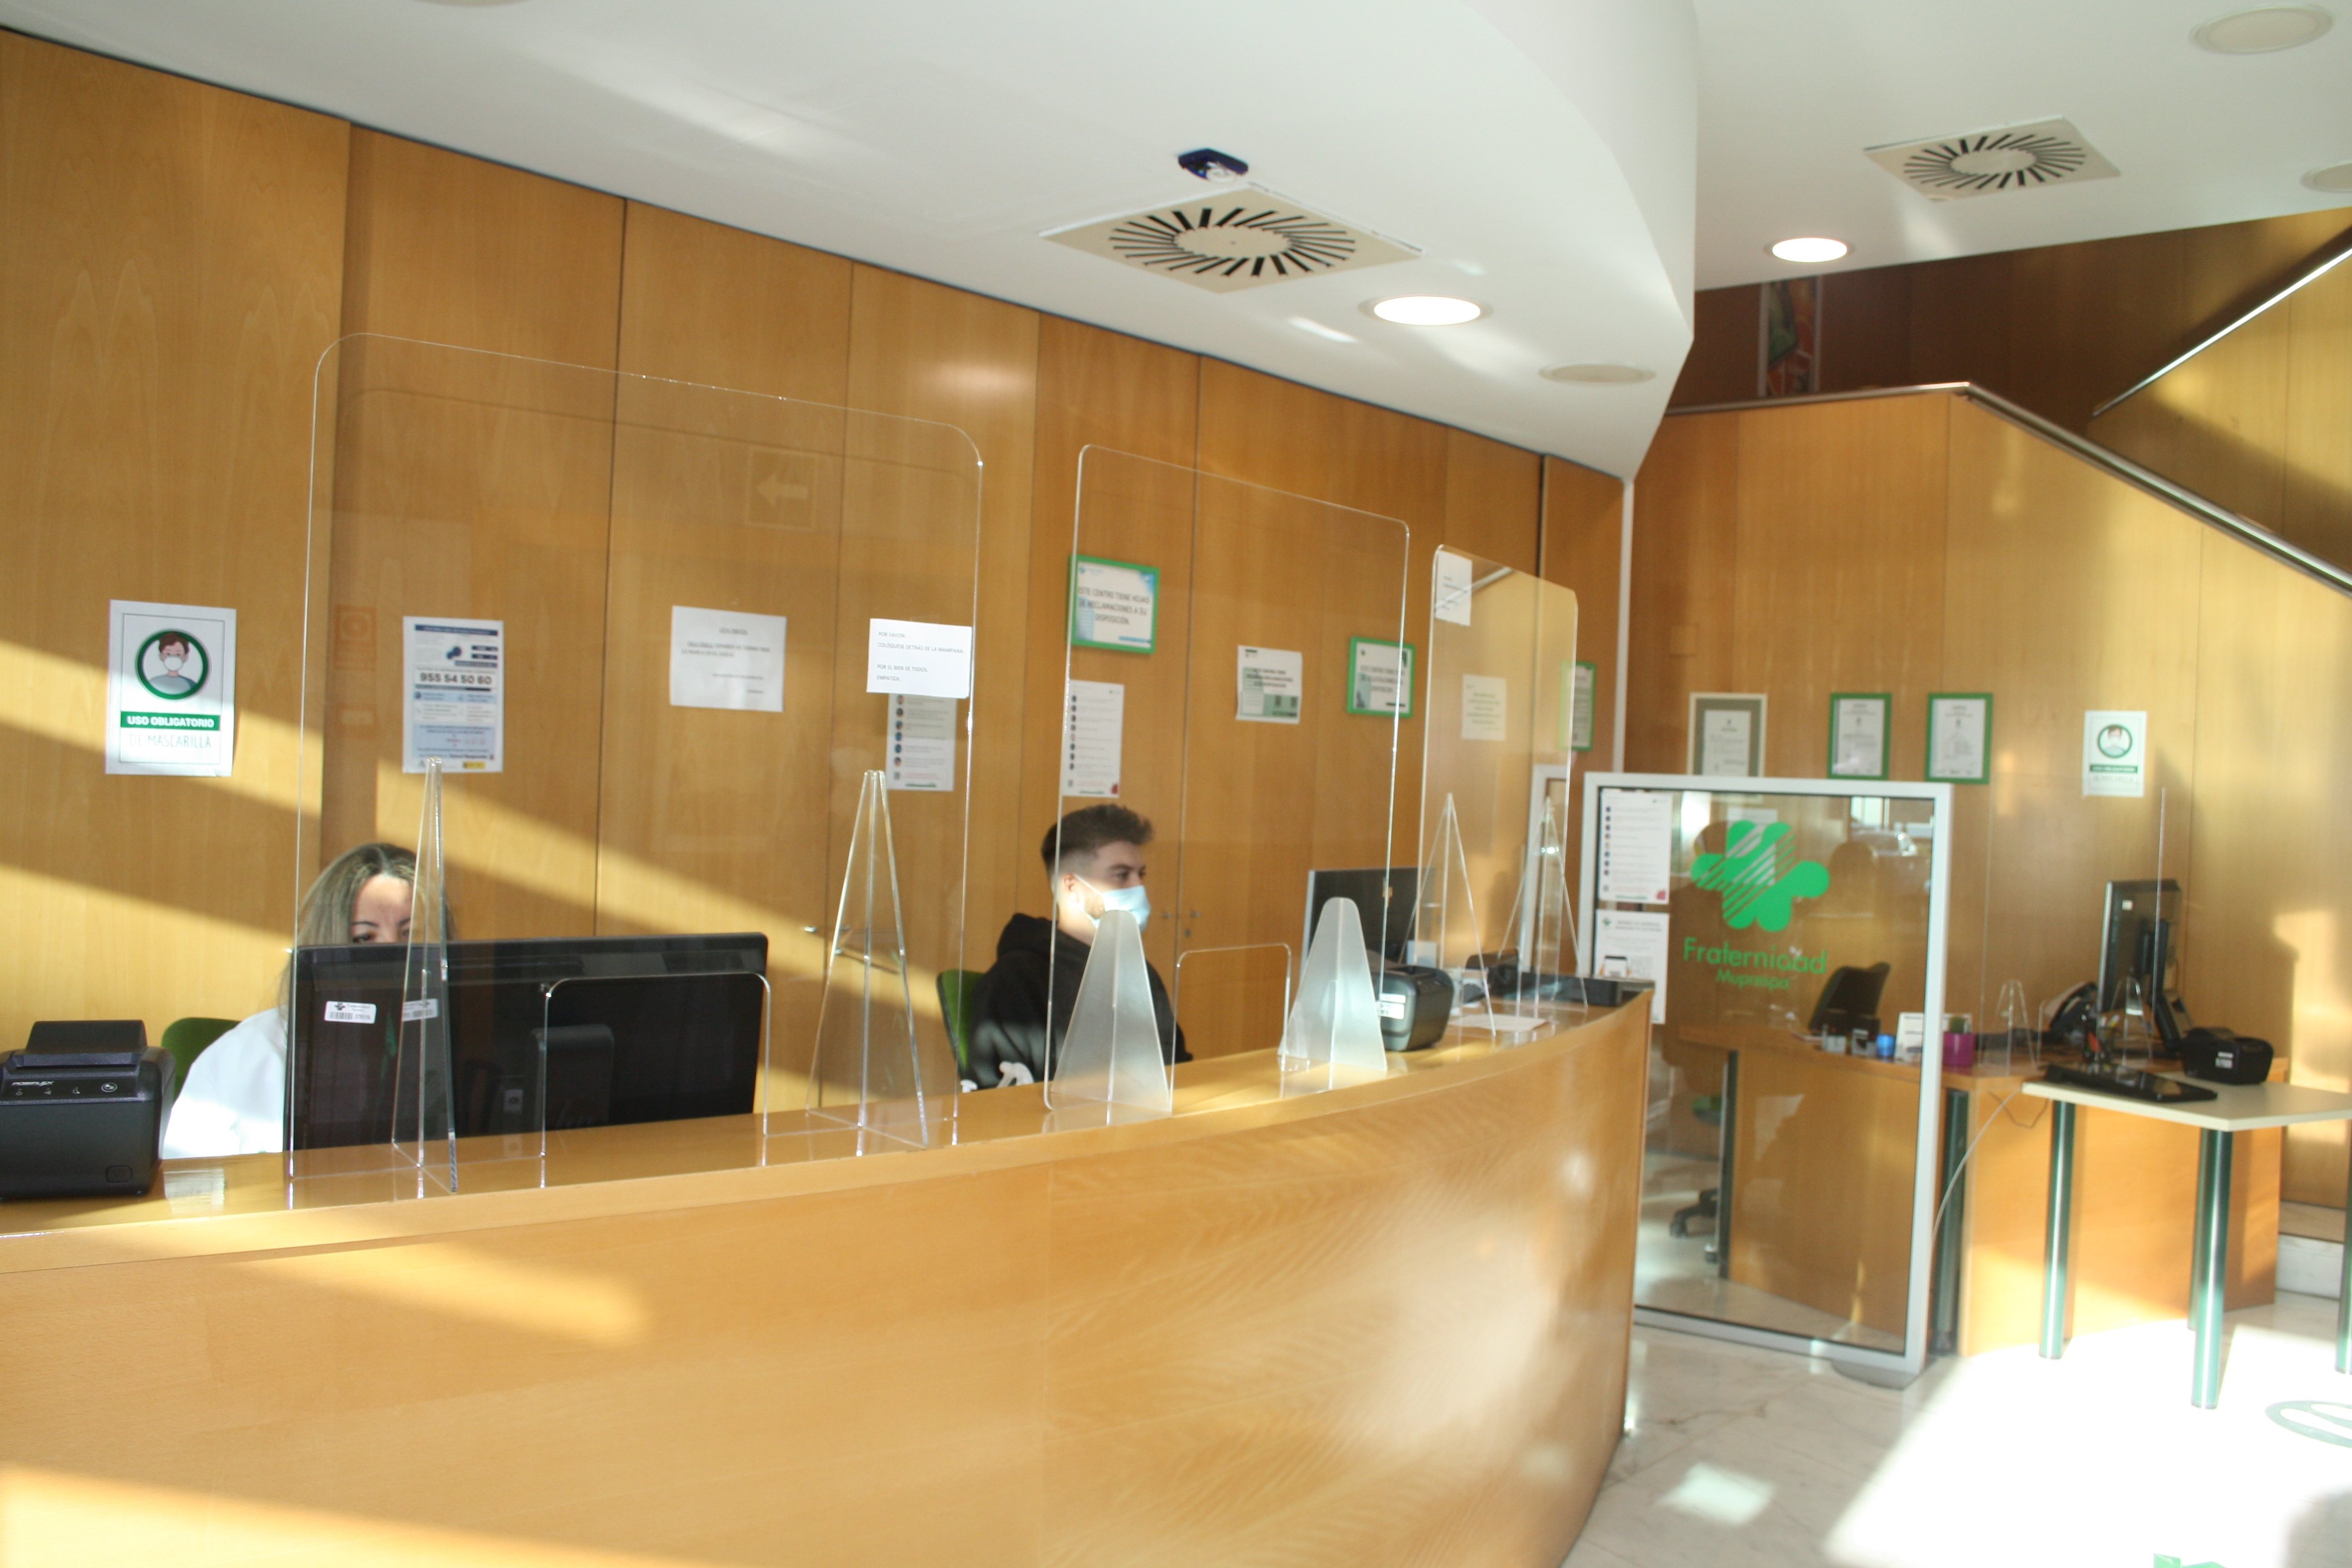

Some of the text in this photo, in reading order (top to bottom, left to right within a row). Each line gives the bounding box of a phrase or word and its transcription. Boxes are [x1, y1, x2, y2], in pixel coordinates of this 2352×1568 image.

[444, 673, 457, 683] 54
[126, 716, 215, 728] USO OBLIGATORIO
[129, 733, 212, 748] DE MASCARILLA
